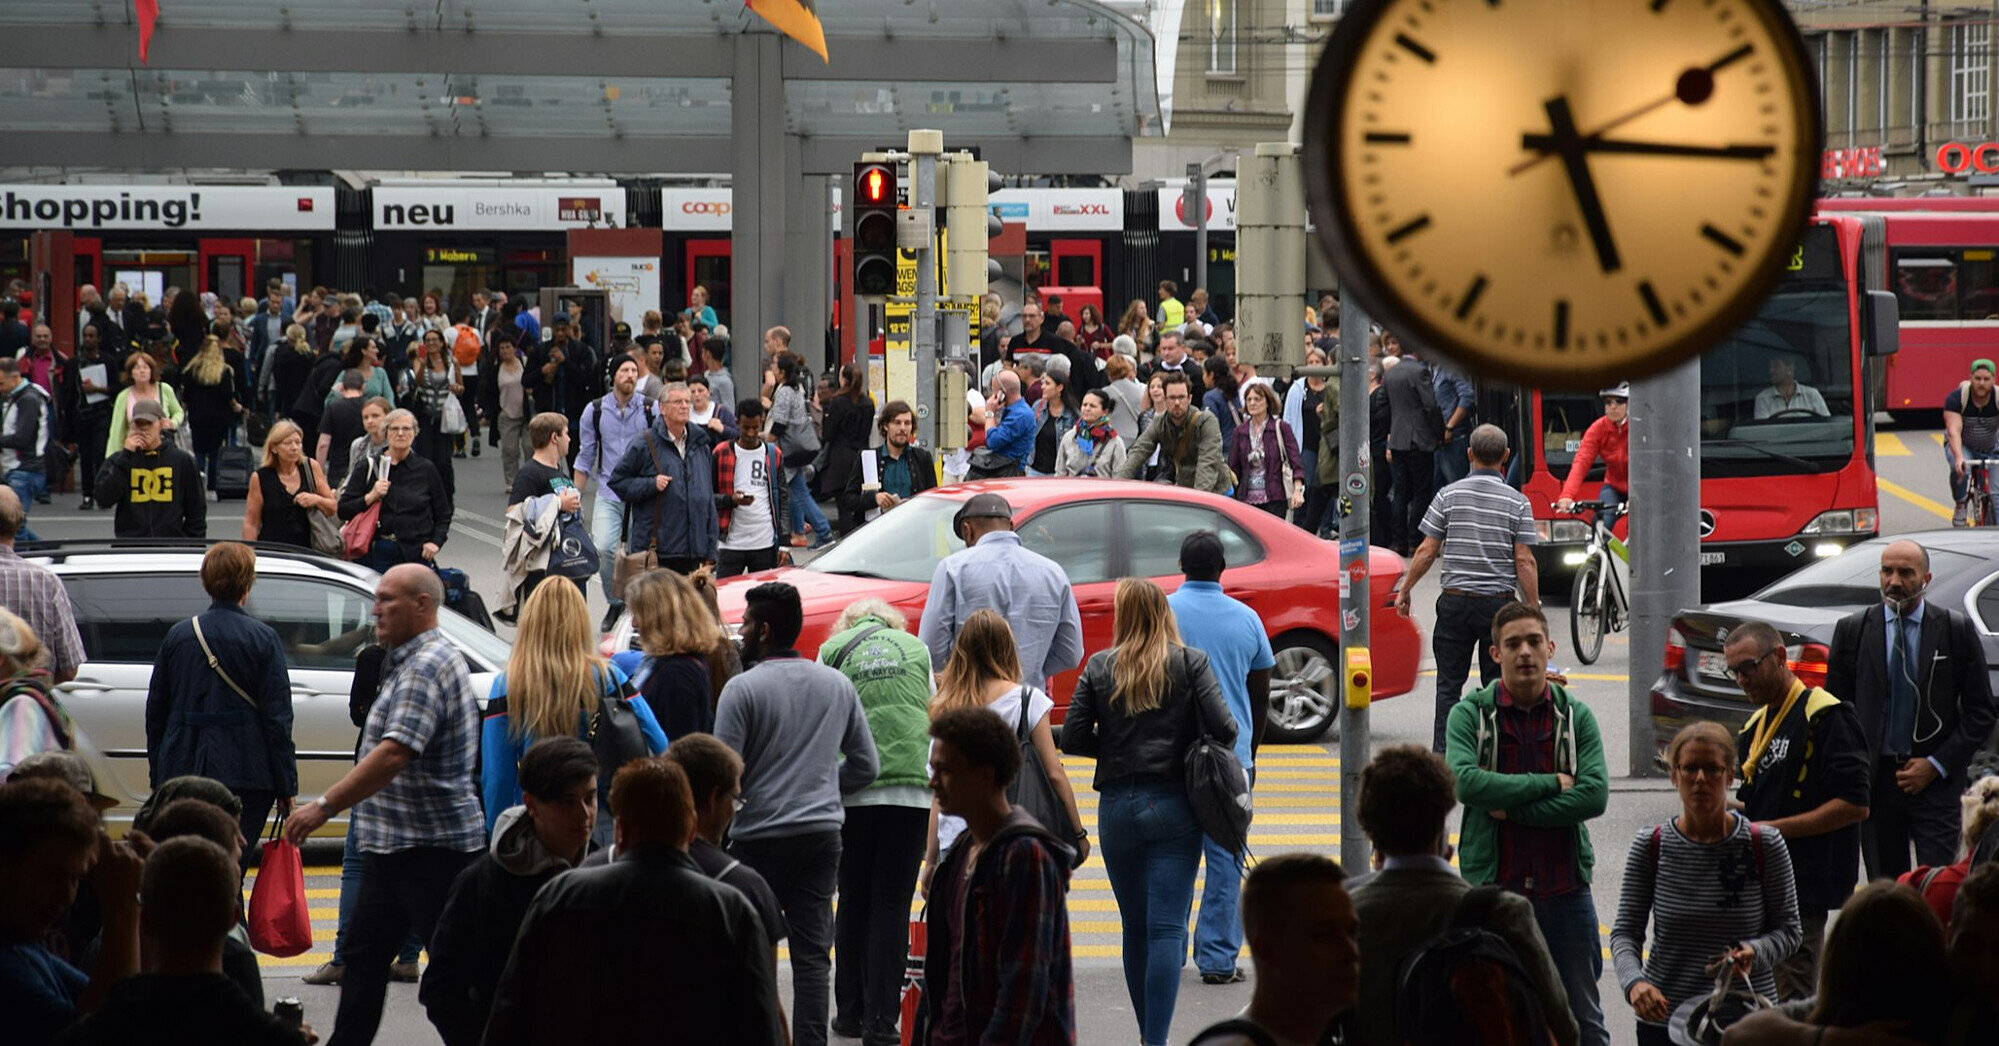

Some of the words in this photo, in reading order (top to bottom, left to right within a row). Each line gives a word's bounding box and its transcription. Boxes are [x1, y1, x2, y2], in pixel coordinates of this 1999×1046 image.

[0, 192, 201, 227] hopping!
[383, 203, 454, 225] neu
[475, 202, 531, 216] Bershka
[682, 202, 731, 217] coop
[1080, 204, 1110, 215] XXL
[427, 250, 434, 262] 9
[131, 466, 173, 503] DC
[871, 668, 887, 677] WAY
